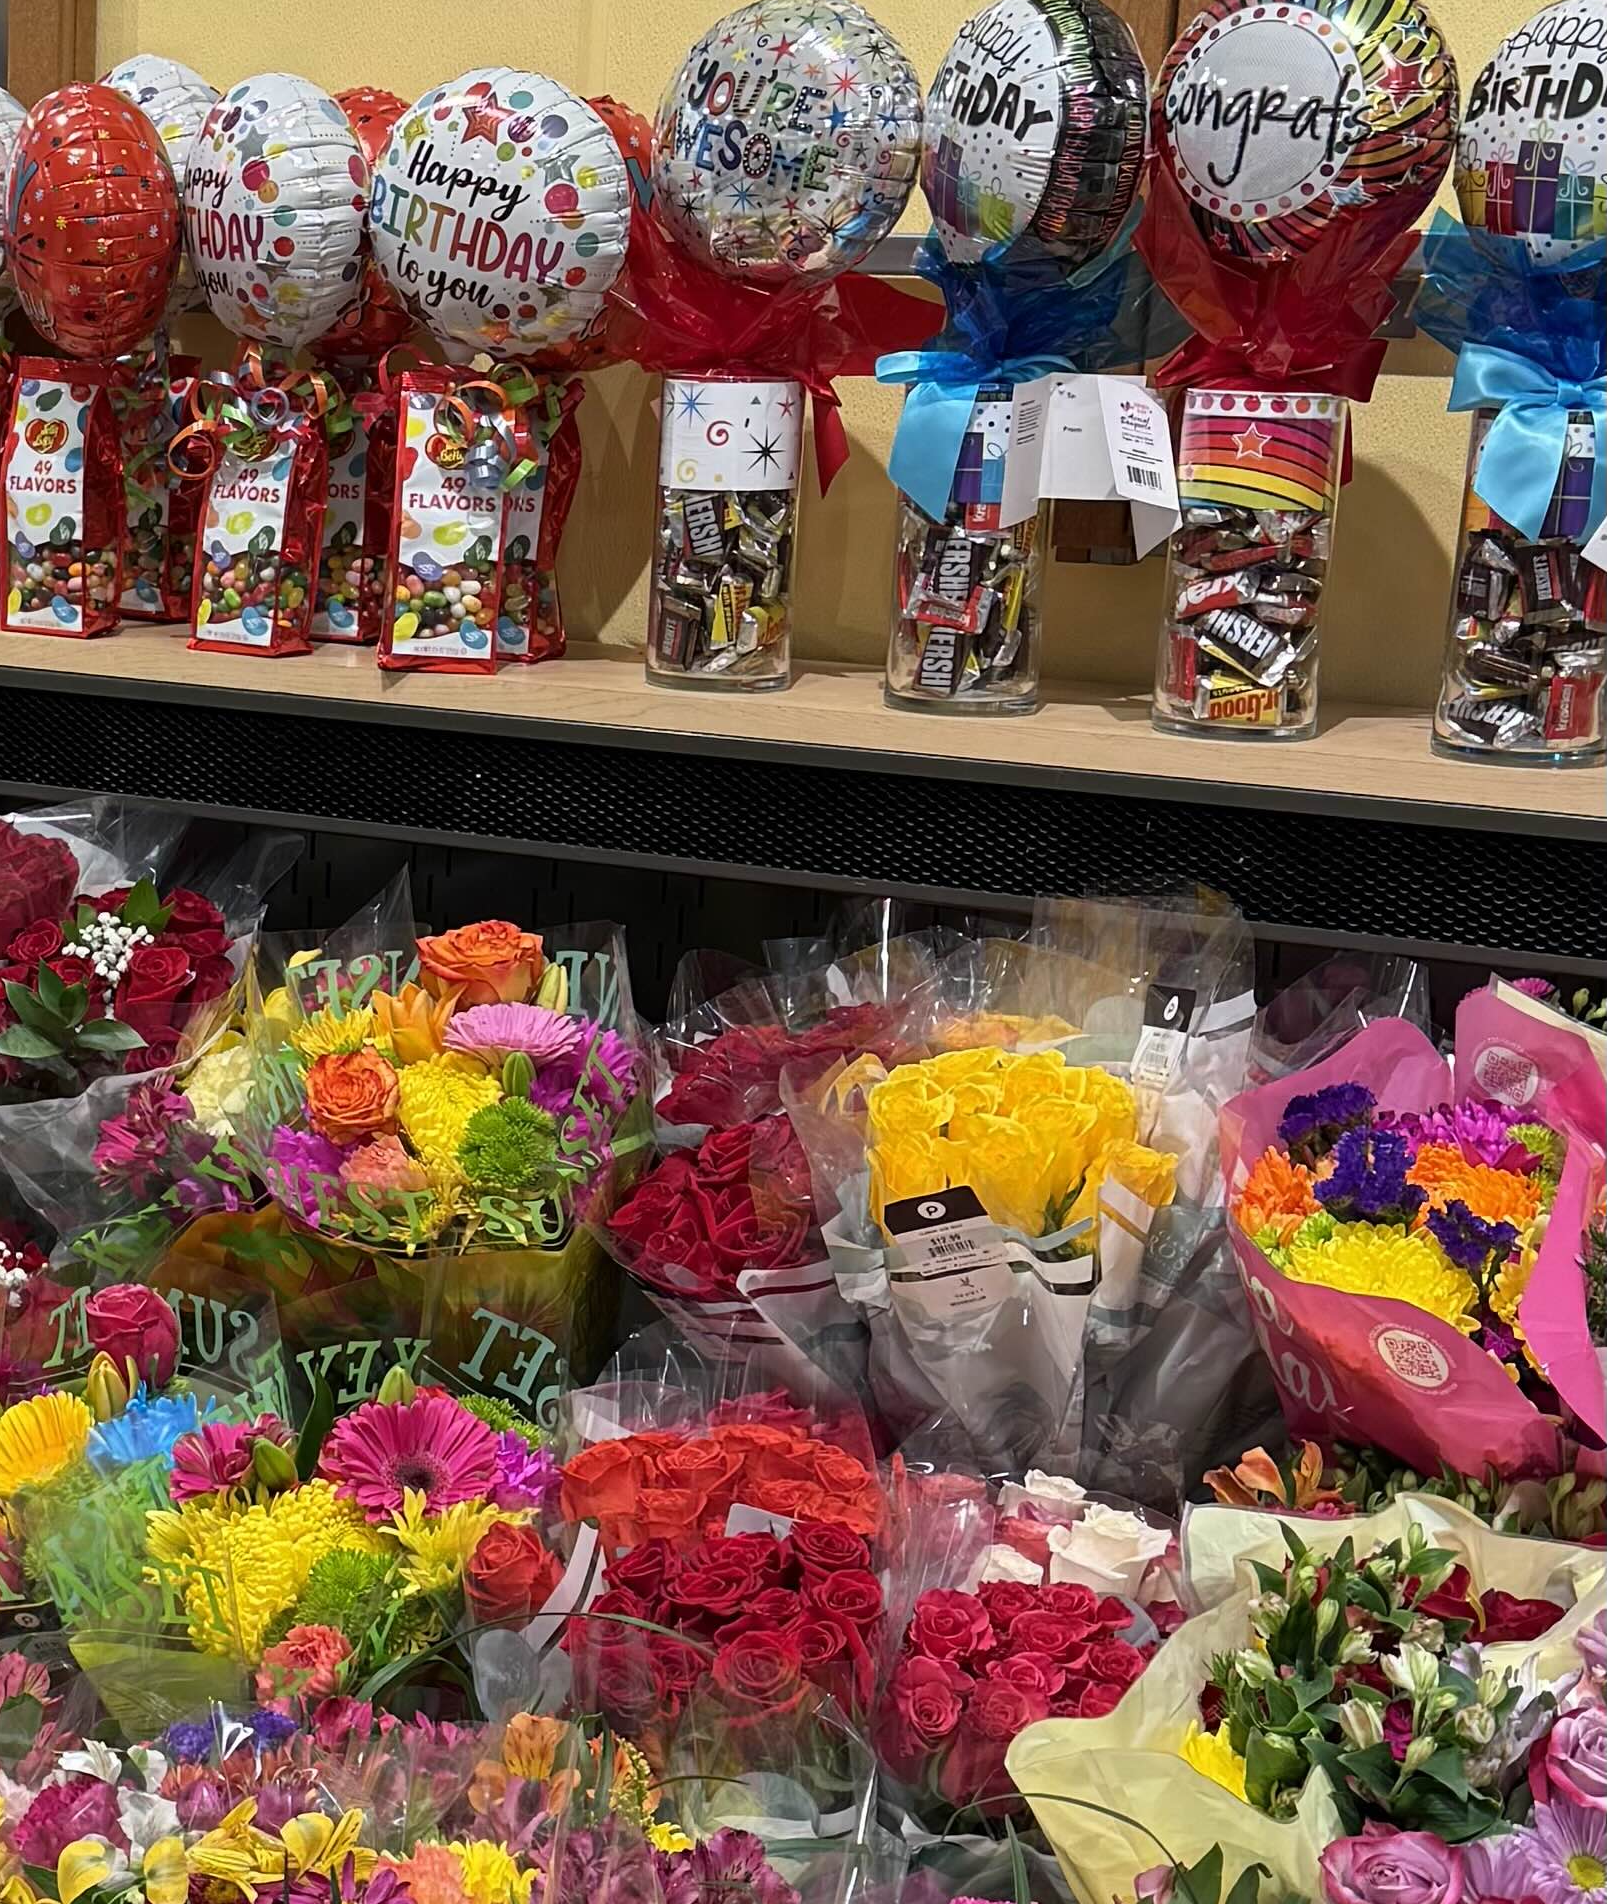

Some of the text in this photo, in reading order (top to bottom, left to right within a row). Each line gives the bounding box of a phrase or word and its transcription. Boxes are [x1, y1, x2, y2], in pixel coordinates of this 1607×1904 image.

[1498, 15, 1607, 64] Happ
[658, 104, 840, 192] AWESOME
[407, 140, 531, 222] Happy
[370, 174, 565, 284] BIRTHDAY
[424, 267, 496, 309] you
[34, 459, 53, 475] 49
[238, 468, 260, 484] 49
[9, 475, 78, 495] FLAVORS
[214, 484, 281, 504] FLAVORS
[441, 476, 467, 493] 49
[409, 493, 496, 513] FLAVORS
